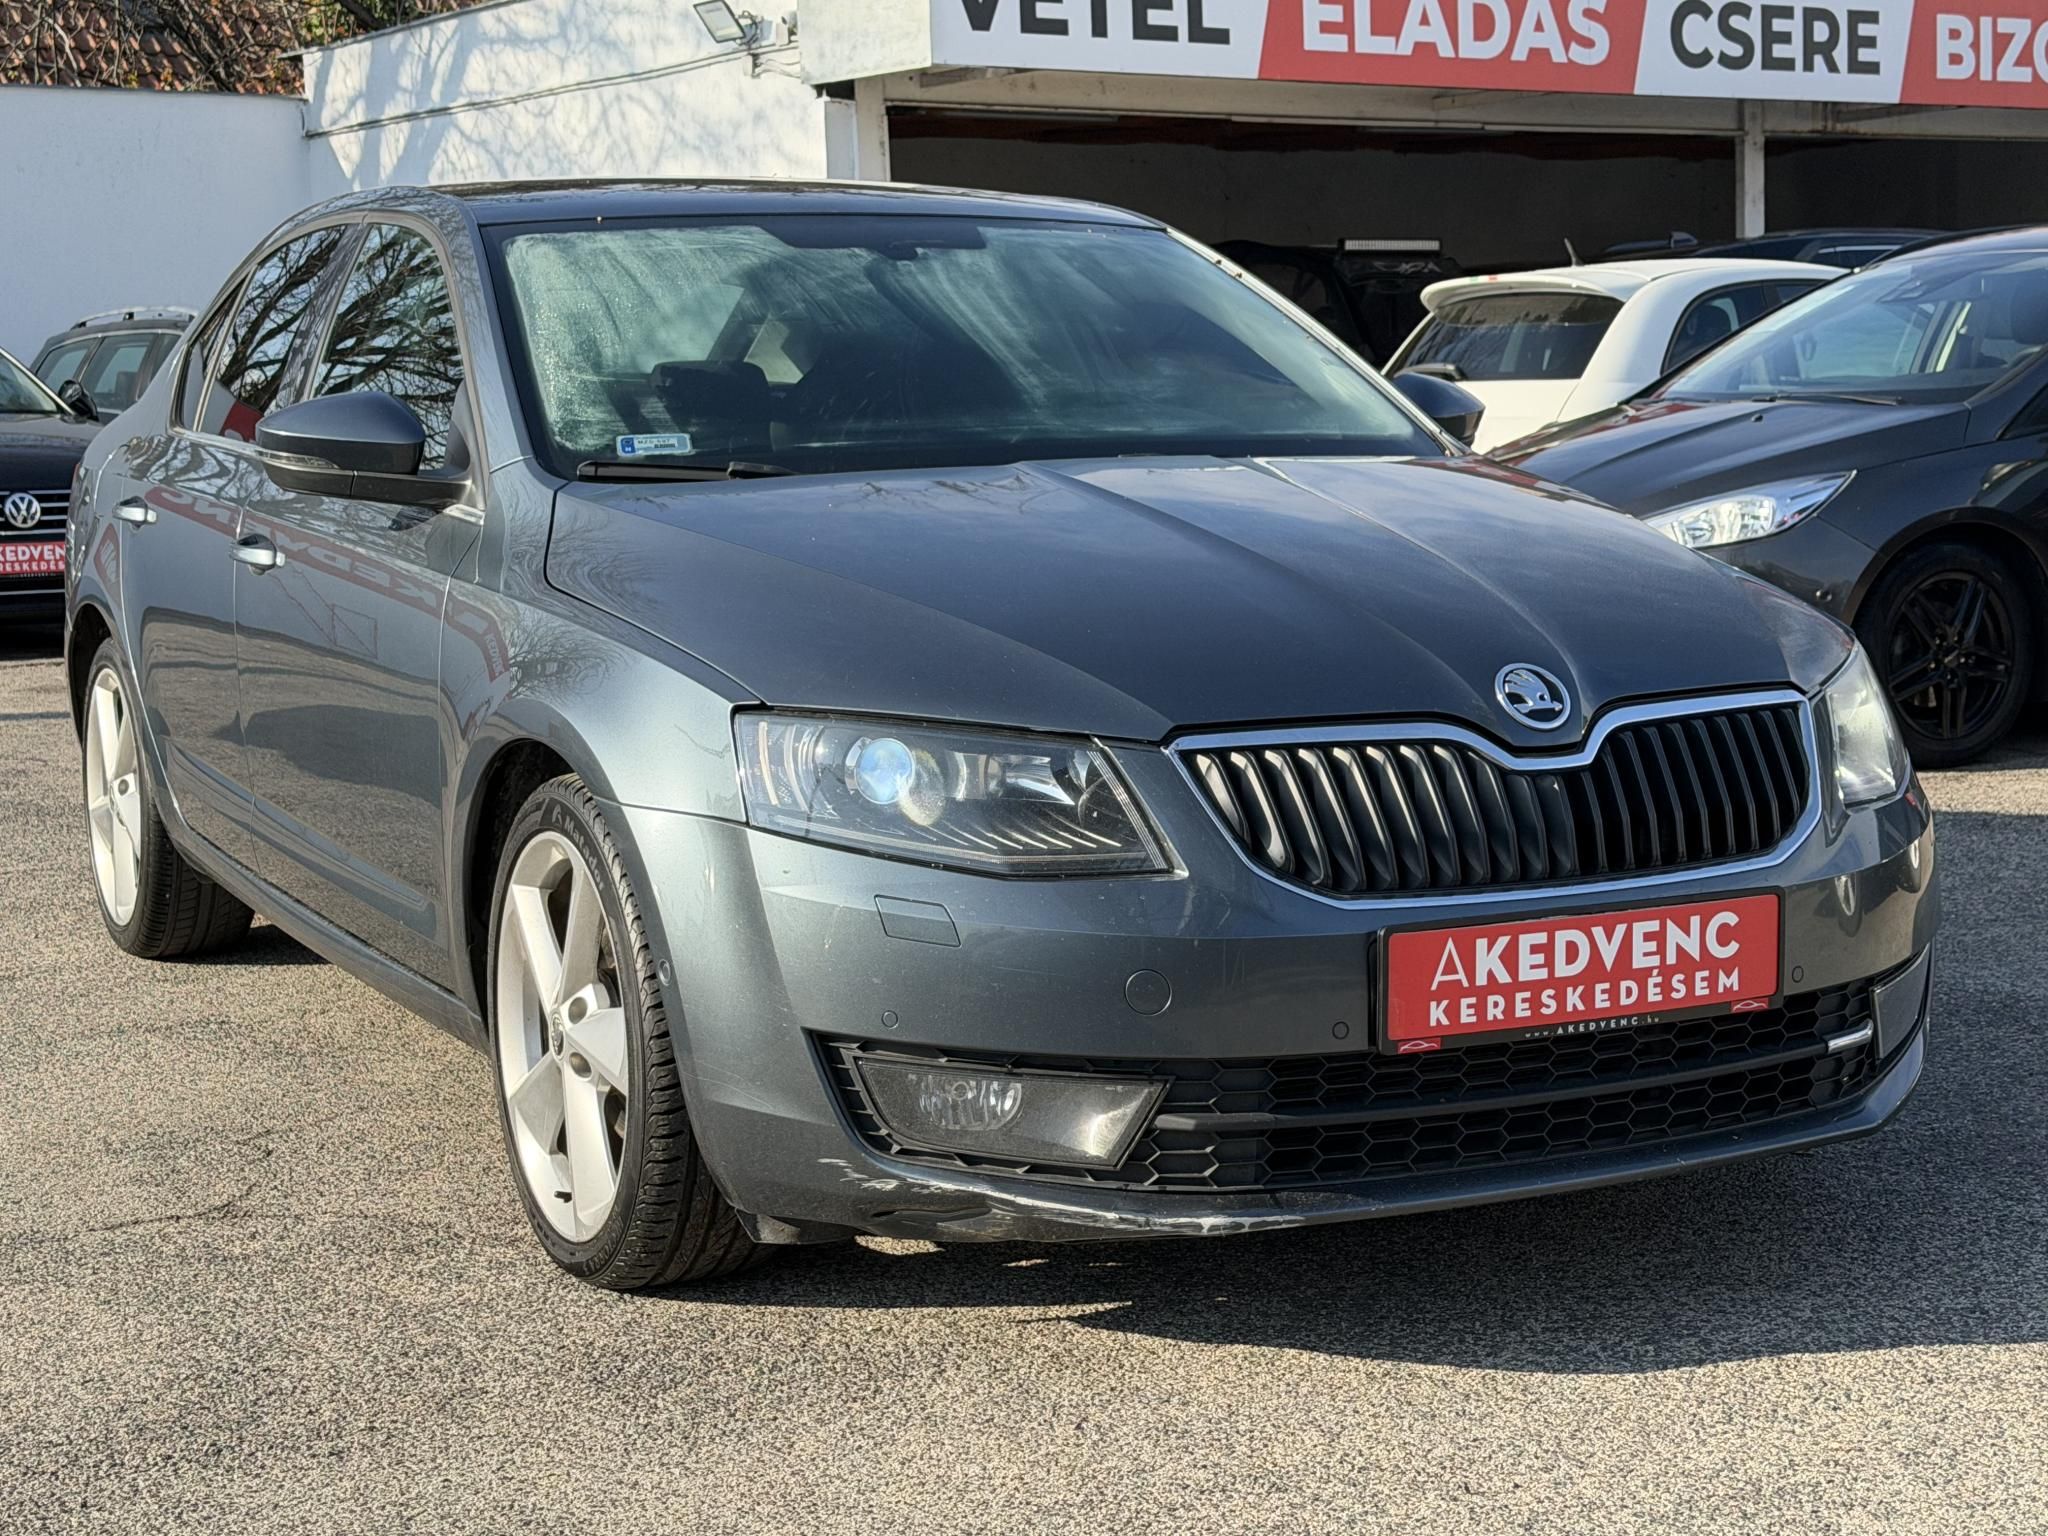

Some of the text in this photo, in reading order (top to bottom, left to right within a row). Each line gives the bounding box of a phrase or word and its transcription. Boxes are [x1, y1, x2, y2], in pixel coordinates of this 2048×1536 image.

[1670, 0, 1881, 75] CSERE
[1430, 911, 1740, 991] AKEDVENC
[1429, 967, 1740, 1027] KERESKEDÉSEM
[1525, 1014, 1660, 1038] www.AKEDVENC.hu
